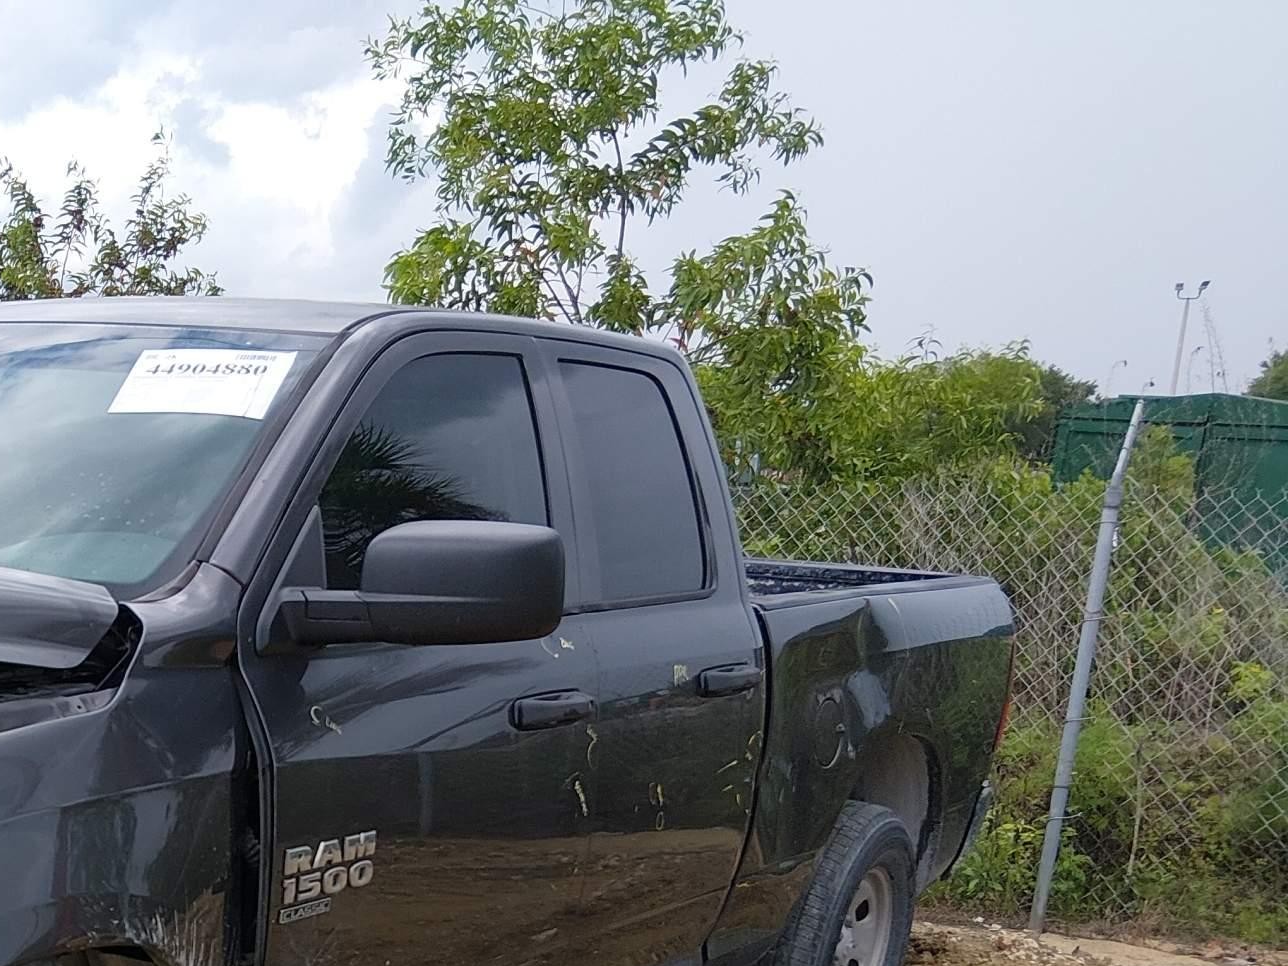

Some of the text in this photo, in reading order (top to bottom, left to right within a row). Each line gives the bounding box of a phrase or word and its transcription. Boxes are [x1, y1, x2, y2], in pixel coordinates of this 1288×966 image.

[145, 362, 269, 376] 44904880
[283, 829, 377, 876] RAM
[282, 859, 374, 905] 1500
[281, 899, 331, 922] CLASSIC
